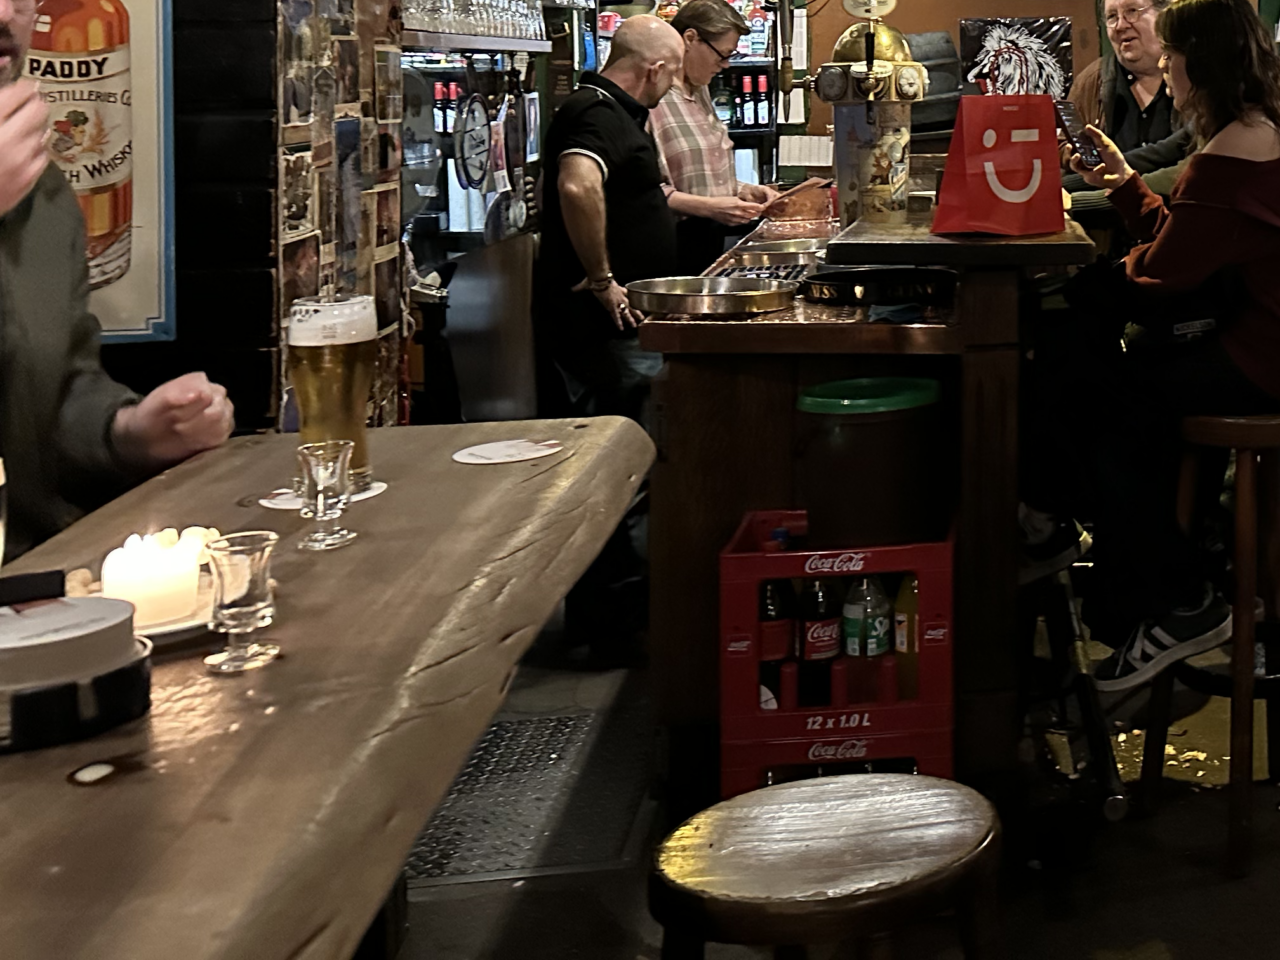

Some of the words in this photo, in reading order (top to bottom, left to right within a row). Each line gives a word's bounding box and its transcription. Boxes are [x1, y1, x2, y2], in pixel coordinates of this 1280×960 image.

[29, 56, 109, 79] PADDY
[804, 552, 866, 574] Coca-Cola
[805, 716, 823, 731] 12
[825, 718, 835, 729] x
[838, 714, 860, 729] 1.0
[861, 713, 872, 727] L
[807, 739, 868, 761] Coca-Cola
